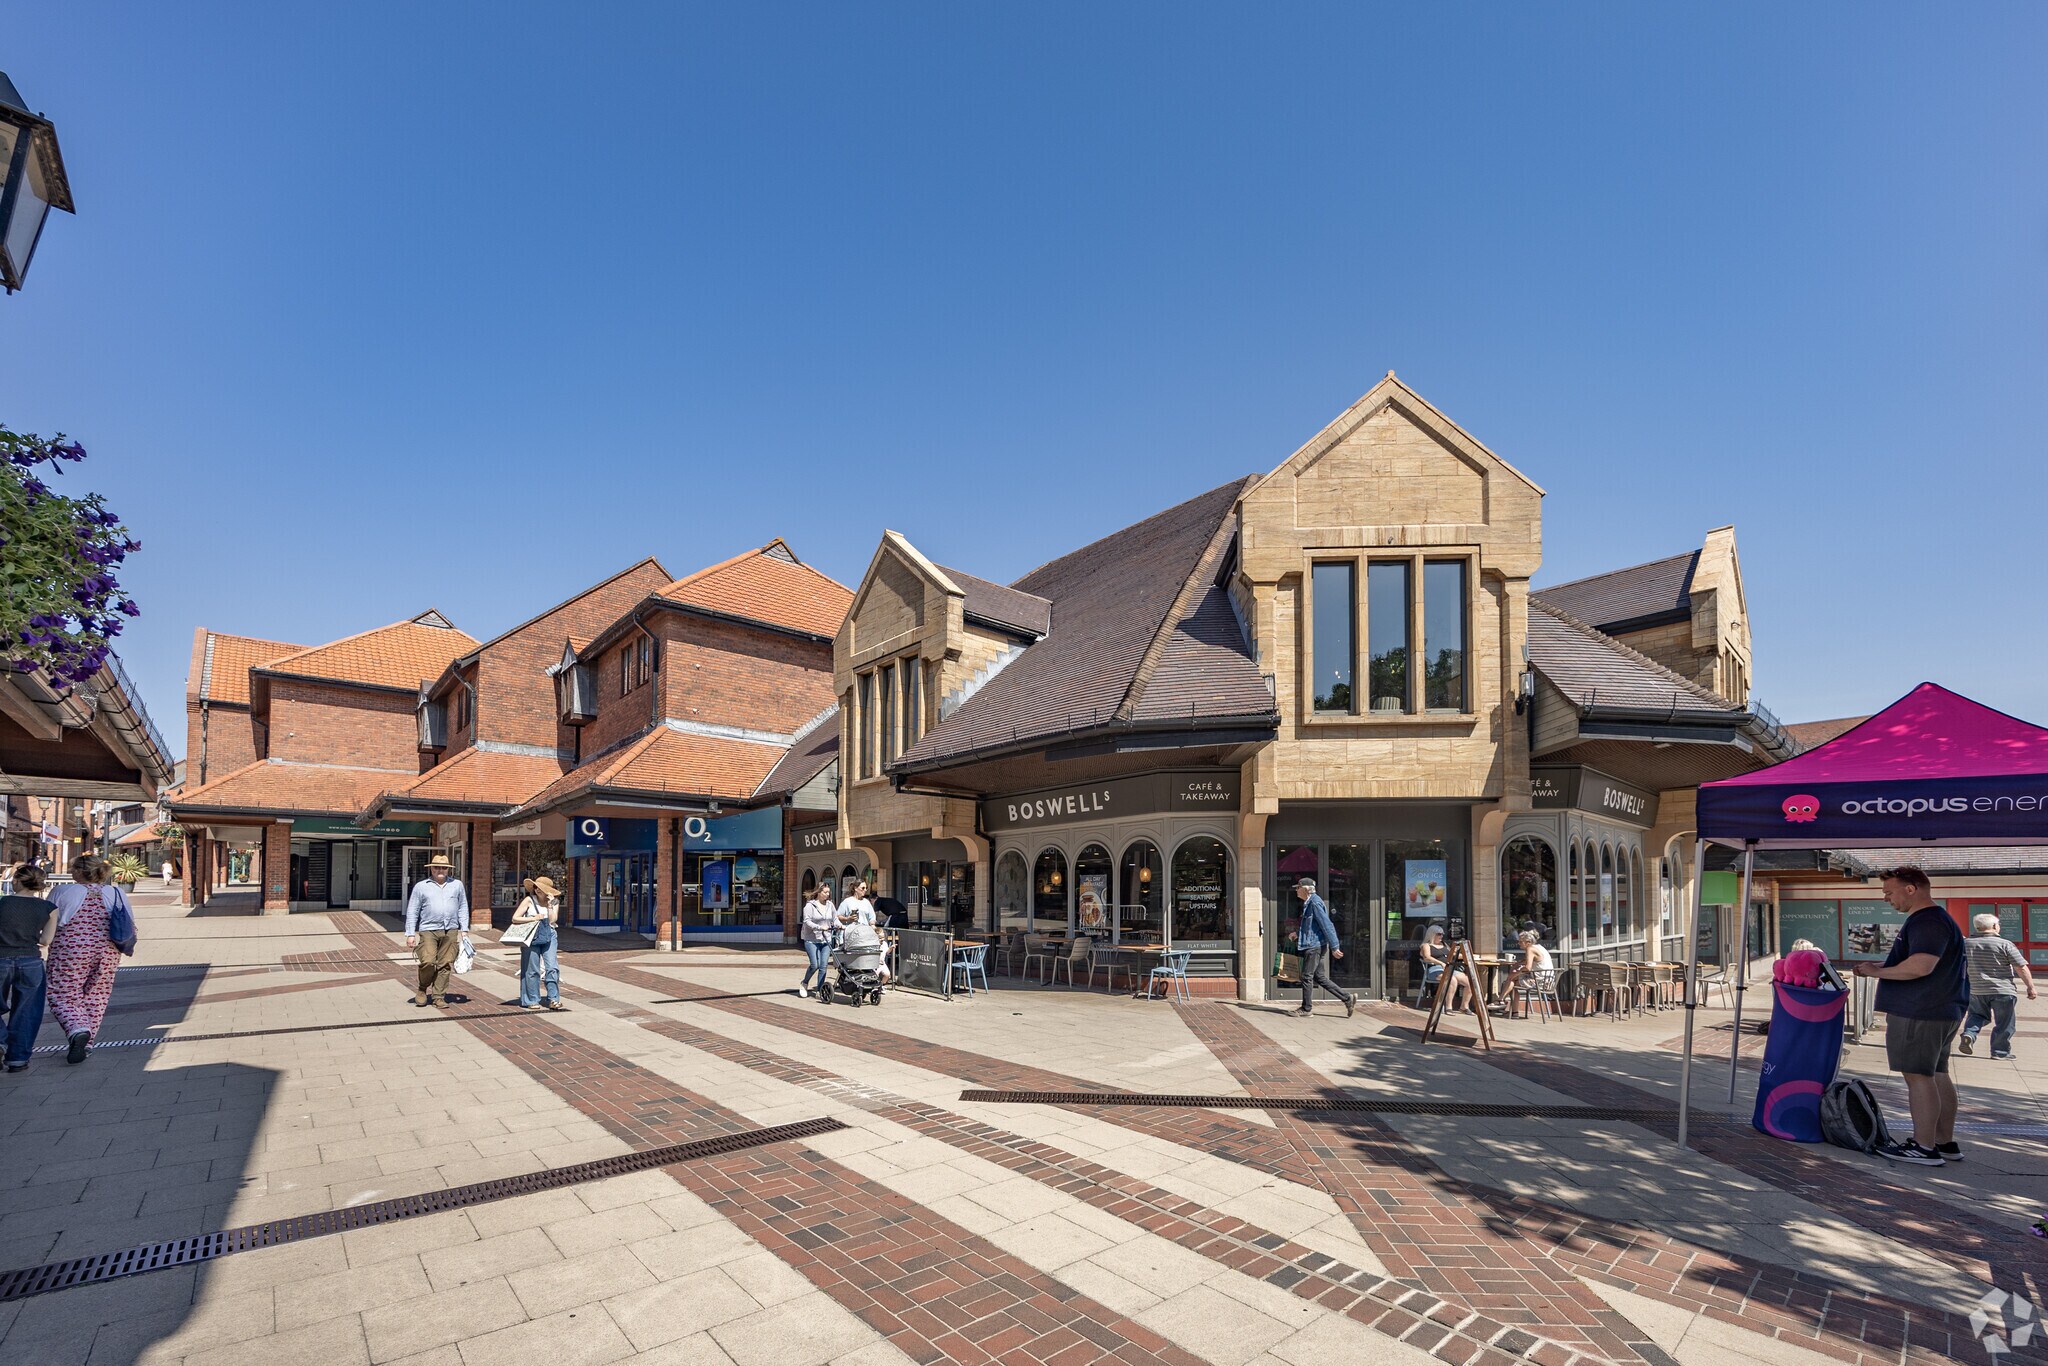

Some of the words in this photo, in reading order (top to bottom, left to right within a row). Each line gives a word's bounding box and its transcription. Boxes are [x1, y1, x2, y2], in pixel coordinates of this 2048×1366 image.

[1188, 781, 1213, 791] CAFÉ
[1544, 779, 1551, 787] &
[1008, 790, 1110, 822] BOSWELLS
[1603, 787, 1645, 816] BOSWELLS
[1841, 797, 1969, 817] octopus
